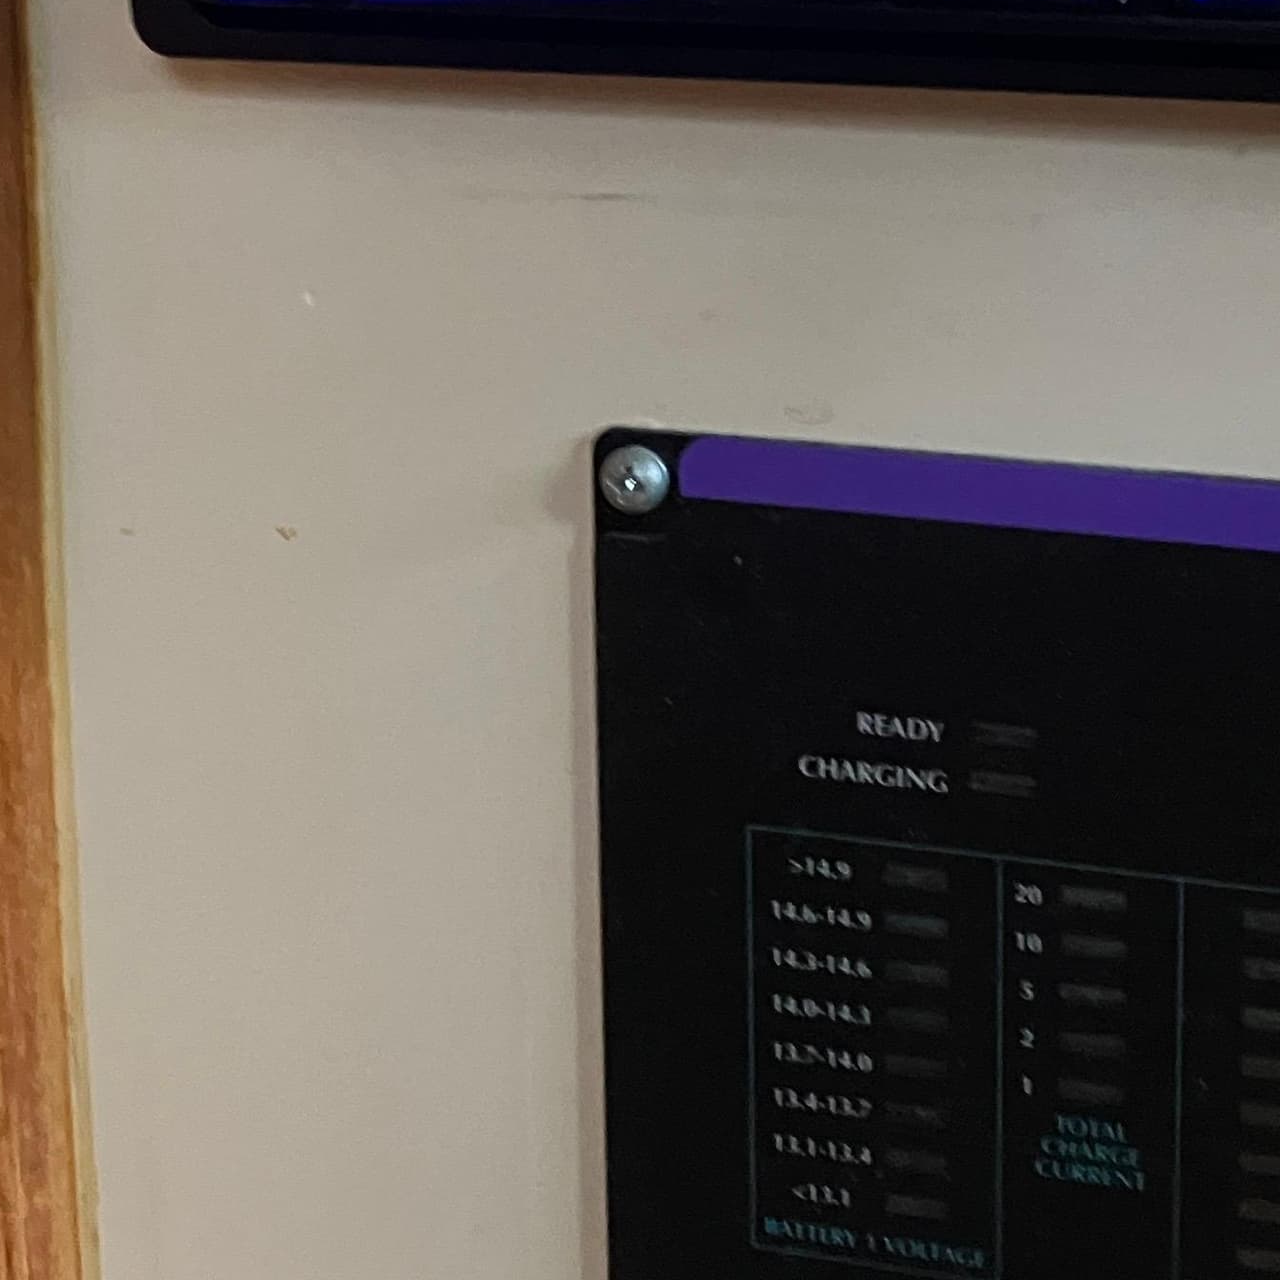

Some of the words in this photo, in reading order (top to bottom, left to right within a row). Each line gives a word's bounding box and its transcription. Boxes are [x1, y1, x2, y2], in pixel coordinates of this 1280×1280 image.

[856, 710, 946, 743] READY
[798, 754, 950, 794] CHARGING
[1013, 880, 1043, 906] 20
[1014, 930, 1043, 954] 10
[1018, 1025, 1036, 1049] 2
